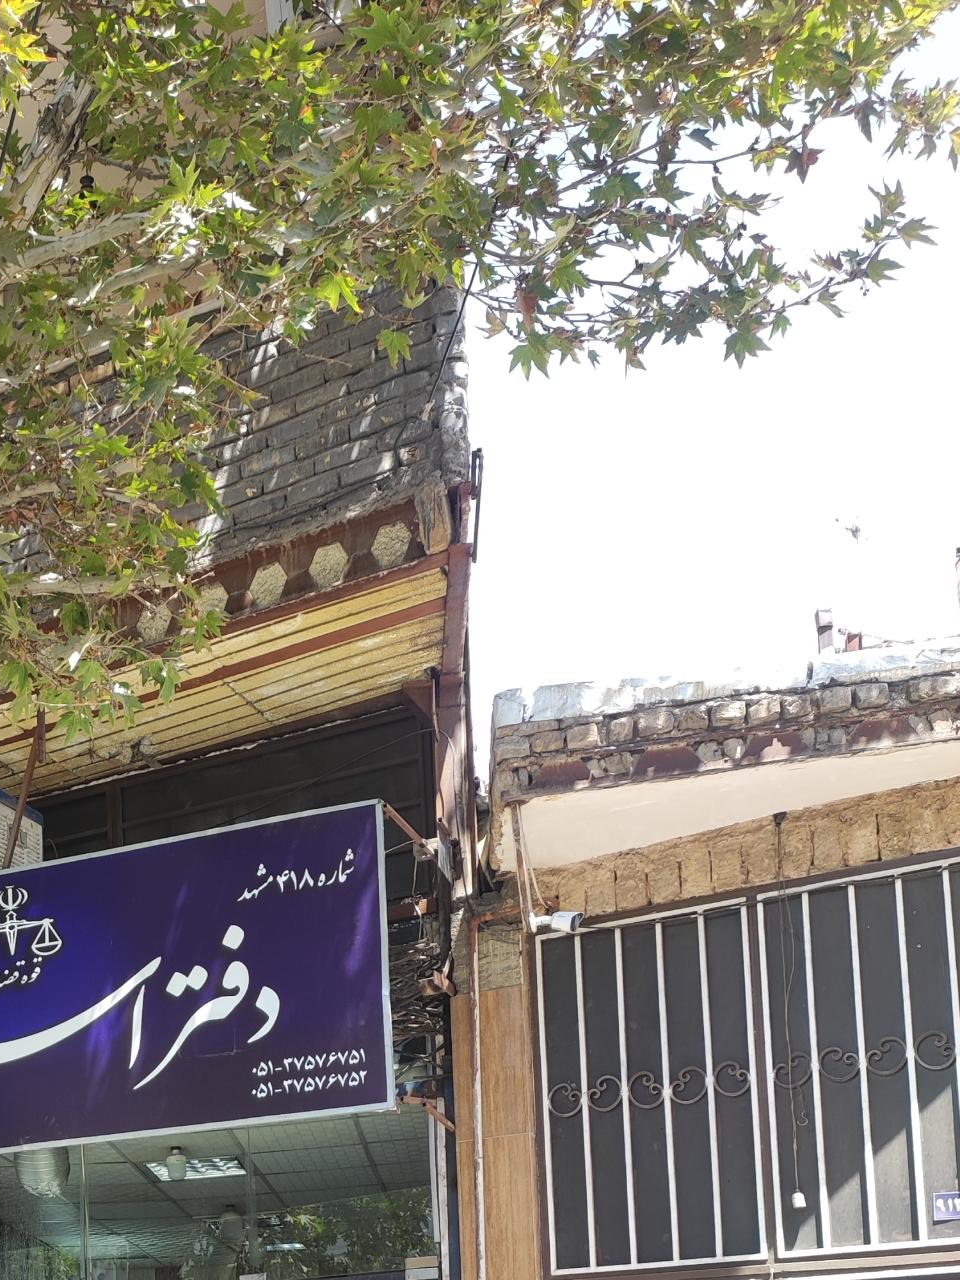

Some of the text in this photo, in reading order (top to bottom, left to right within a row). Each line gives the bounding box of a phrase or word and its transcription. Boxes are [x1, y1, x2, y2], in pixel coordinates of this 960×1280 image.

[237, 848, 355, 902] شماره ۴۱۸ مشهد
[20, 956, 43, 984] قوه
[133, 924, 281, 1091] دفتر
[251, 1048, 367, 1077] ۰۵۱-۳۷۵۷۶۷۵۱
[251, 1070, 368, 1098] ۰۵۱-۳۷۵۷۶۷۵۲
